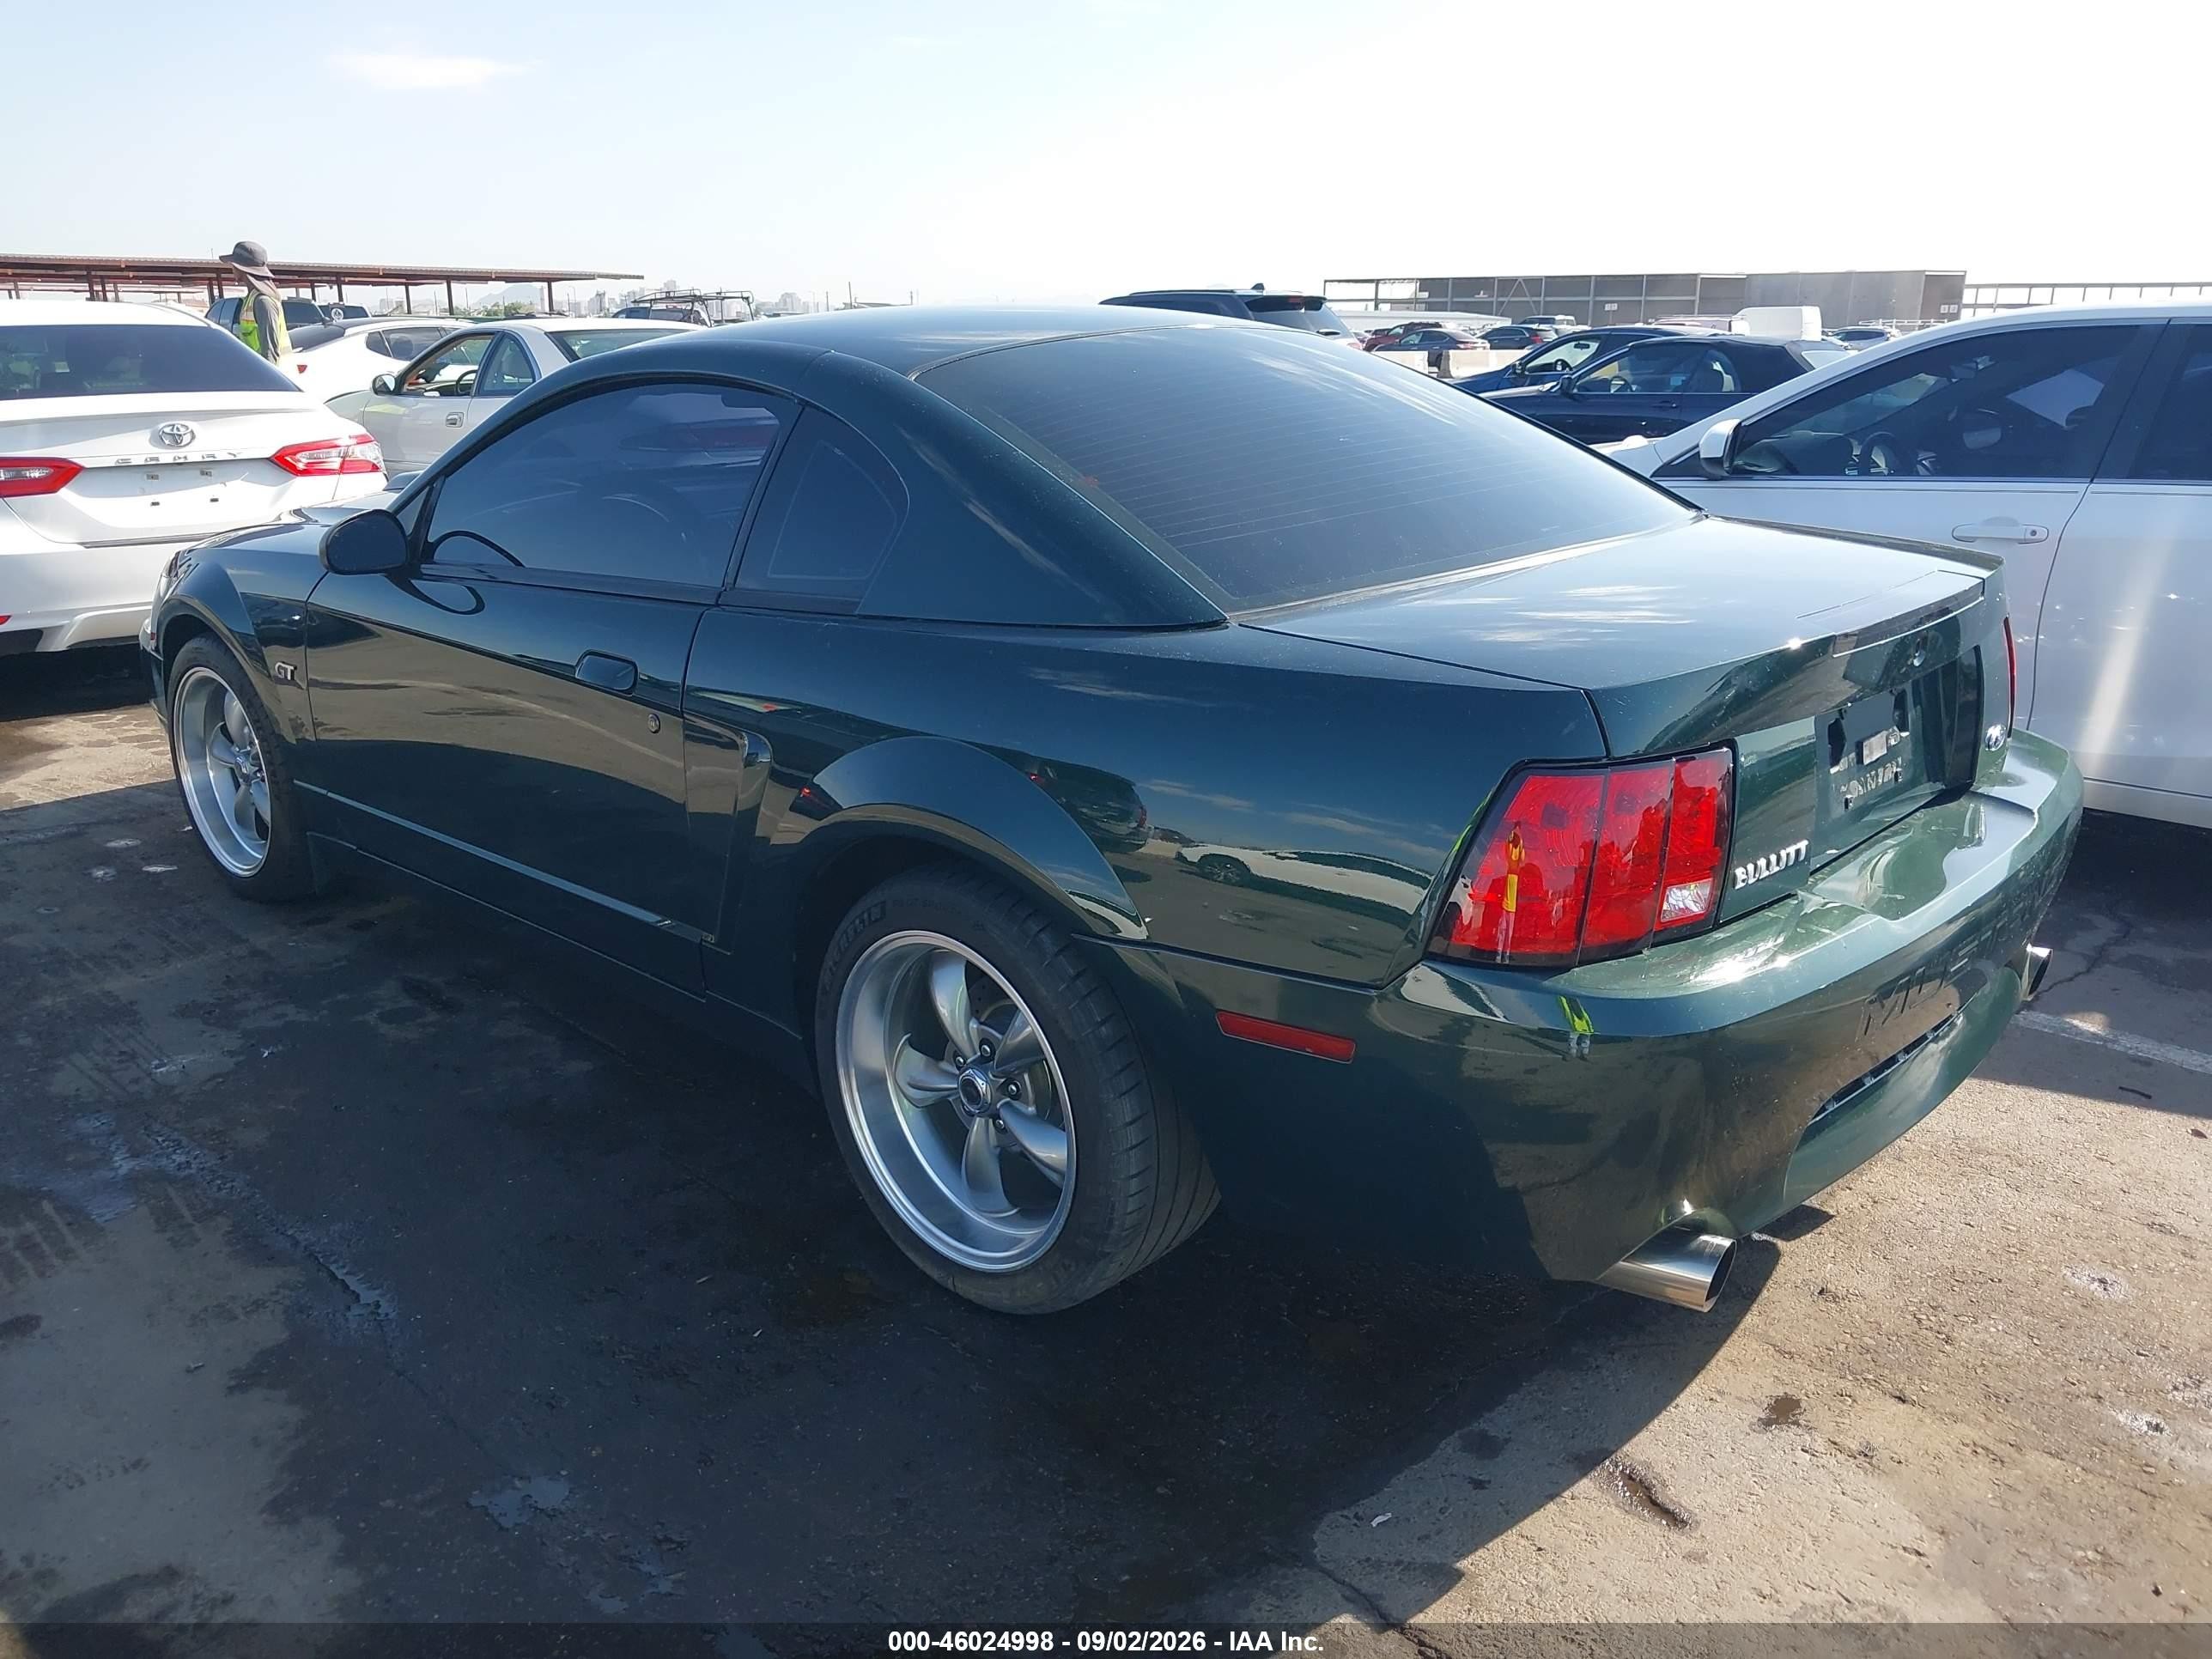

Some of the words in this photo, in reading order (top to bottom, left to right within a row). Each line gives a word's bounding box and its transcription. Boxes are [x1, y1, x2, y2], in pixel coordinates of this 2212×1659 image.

[115, 451, 243, 465] CAMRY
[275, 661, 297, 681] GT
[1734, 839, 1809, 890] BULLITT
